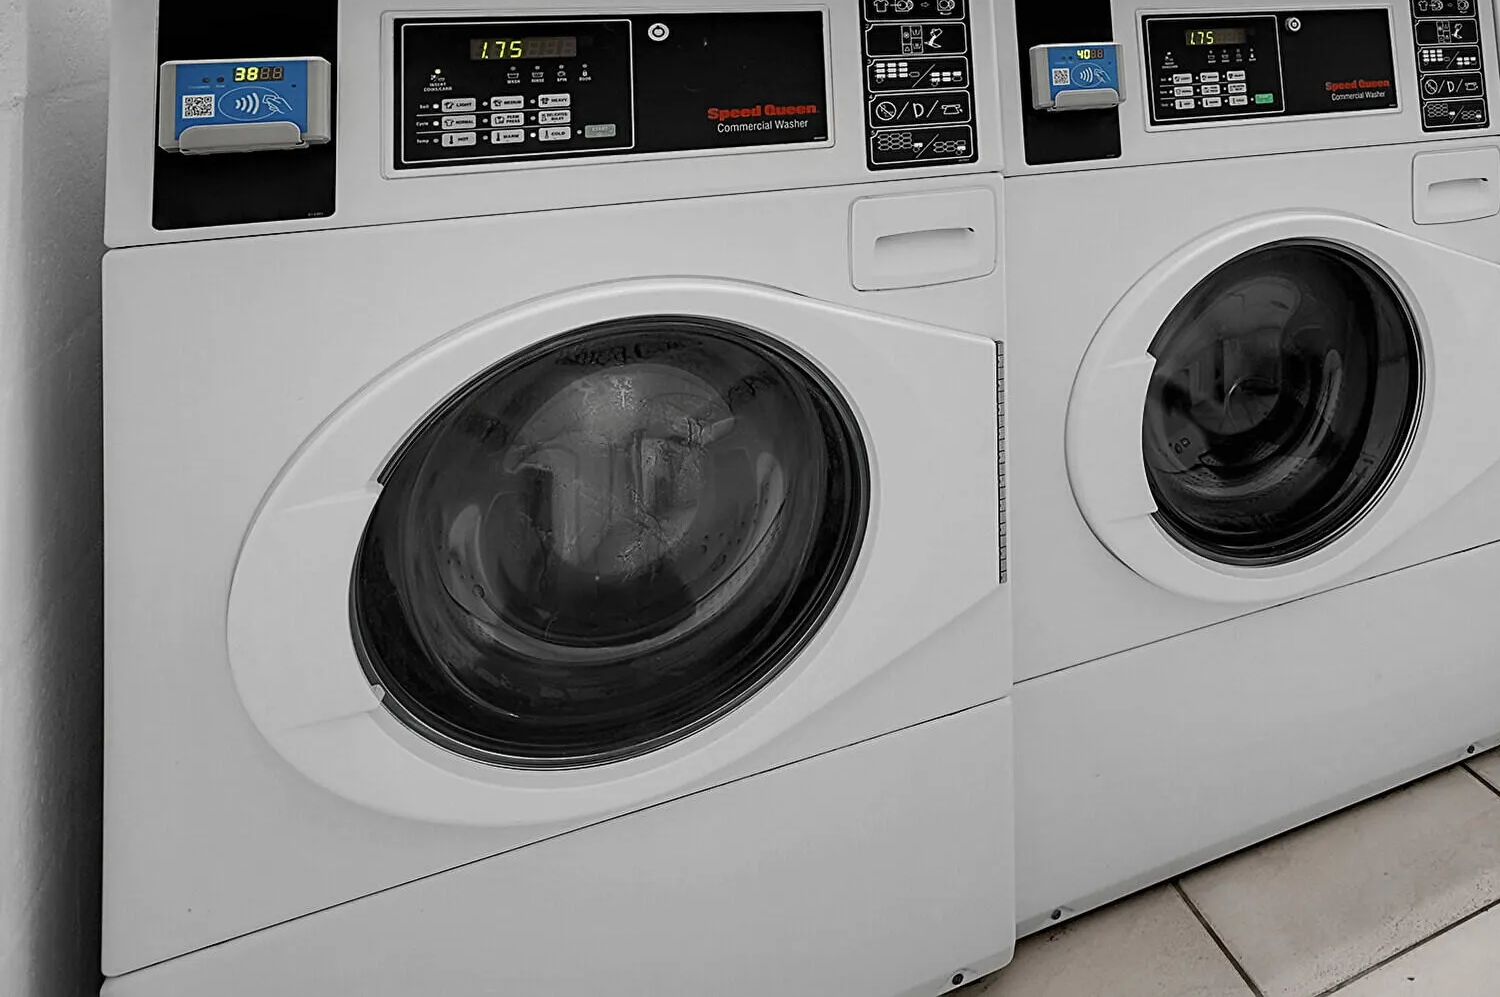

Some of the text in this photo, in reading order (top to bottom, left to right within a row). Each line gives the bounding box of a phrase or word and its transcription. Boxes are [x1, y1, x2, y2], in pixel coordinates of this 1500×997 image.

[481, 40, 523, 59] 1.75
[1326, 79, 1390, 92] Speed Queen
[1332, 91, 1385, 101] Commercial Washer
[708, 104, 817, 121] Speed Queen
[717, 119, 809, 133] Commercial Washer
